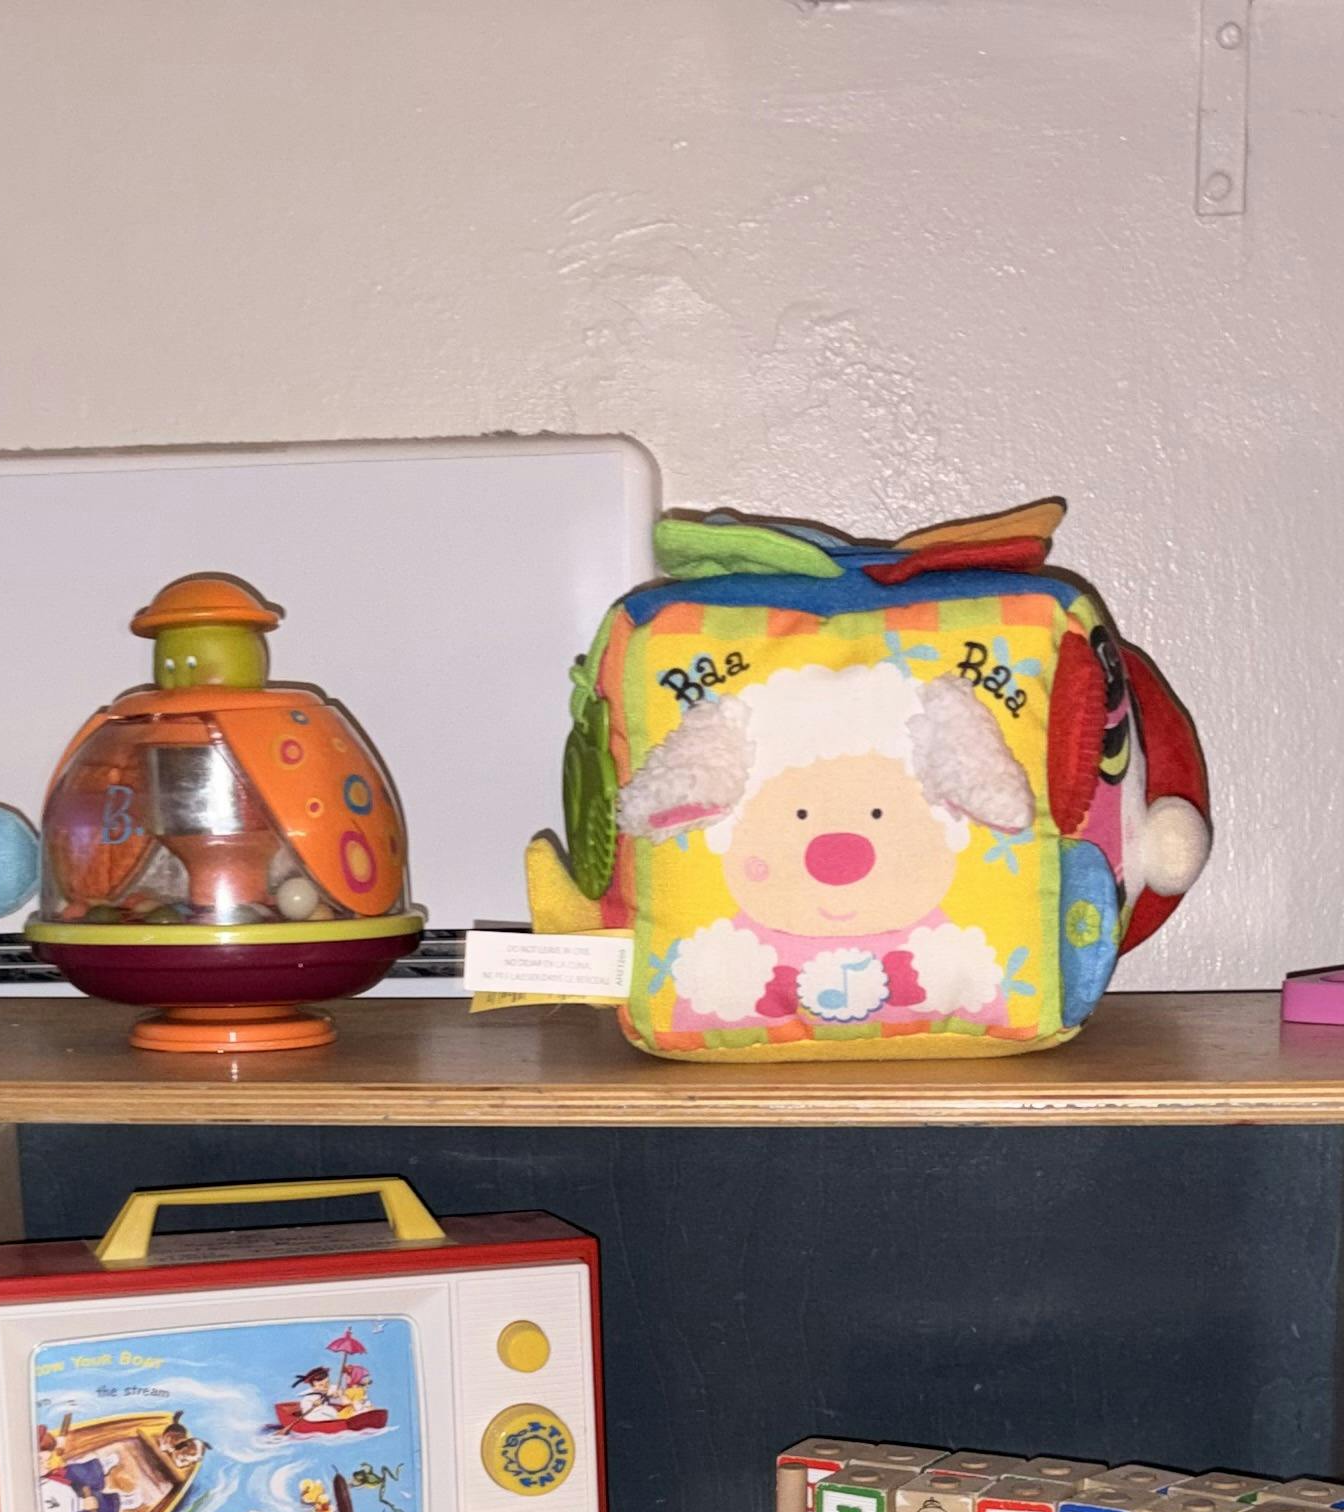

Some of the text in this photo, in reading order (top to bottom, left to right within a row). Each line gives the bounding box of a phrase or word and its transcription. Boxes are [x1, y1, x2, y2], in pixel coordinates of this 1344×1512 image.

[659, 650, 751, 709] Baa
[957, 640, 1029, 719] Baa
[96, 1385, 170, 1398] the stream
[539, 1425, 568, 1488] TURN
